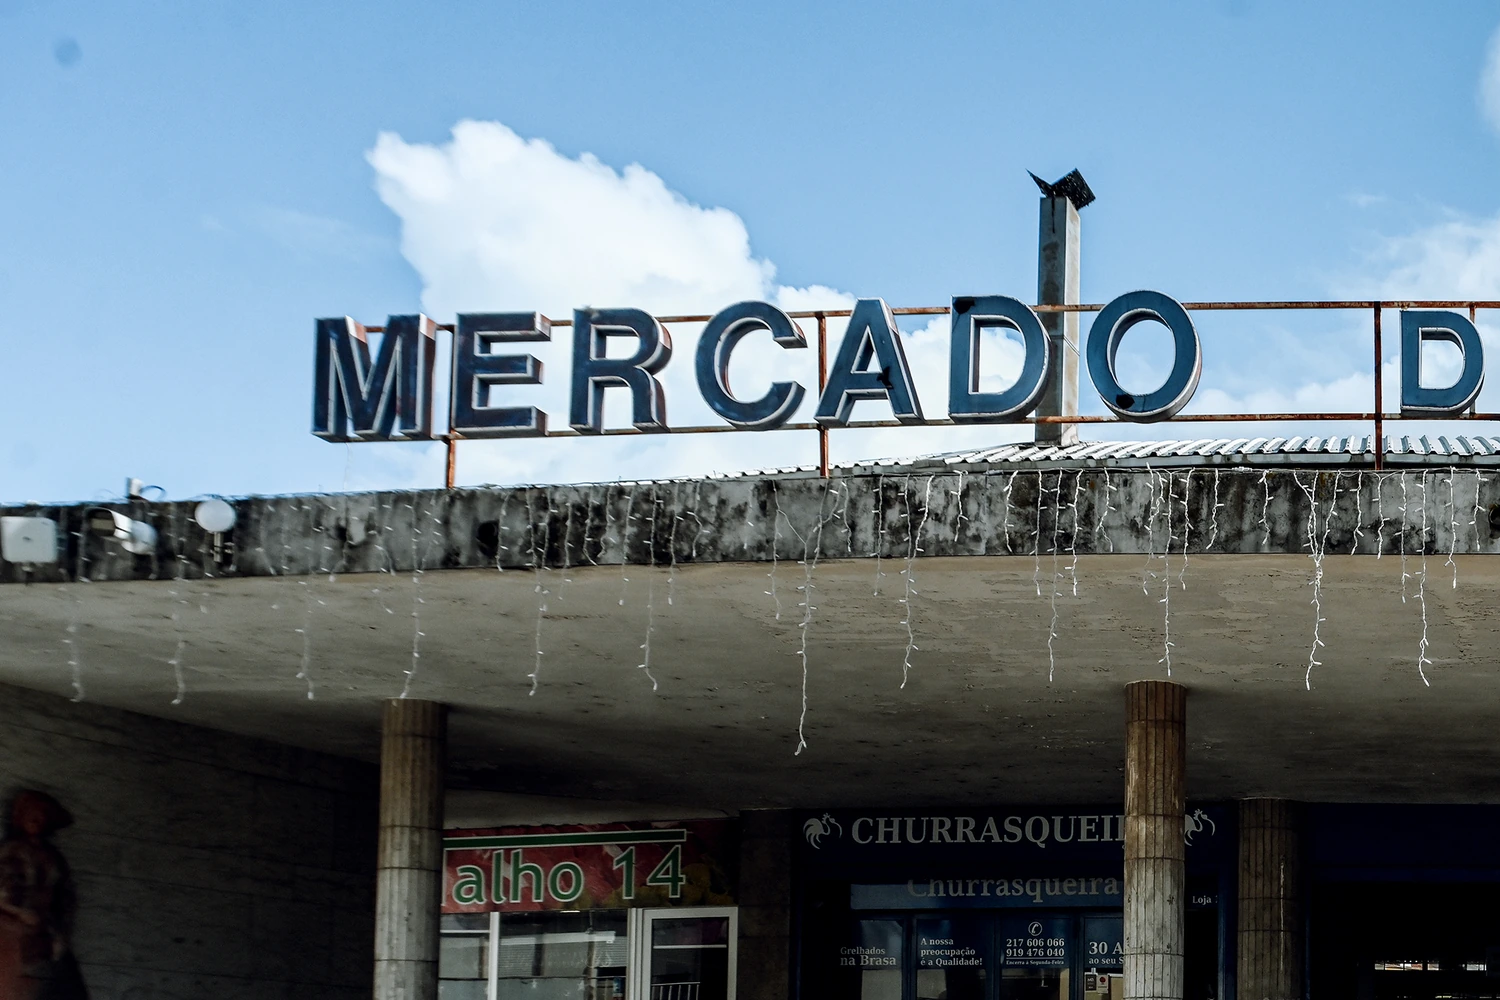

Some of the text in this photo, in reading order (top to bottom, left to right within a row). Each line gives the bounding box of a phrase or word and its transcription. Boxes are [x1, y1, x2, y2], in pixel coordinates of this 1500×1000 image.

[312, 290, 1201, 443] MERCADO
[613, 844, 686, 899] 14
[907, 876, 1119, 904] Churrasqueira
[1192, 894, 1212, 906] Loja
[1006, 938, 1065, 947] 217 606 066
[1088, 941, 1124, 955] 30 A
[839, 946, 886, 955] Grelhados
[920, 947, 976, 957] preocupação
[1006, 948, 1065, 957] 919 476 040
[839, 955, 897, 966] na Brasa
[935, 957, 983, 966] Qualidade!
